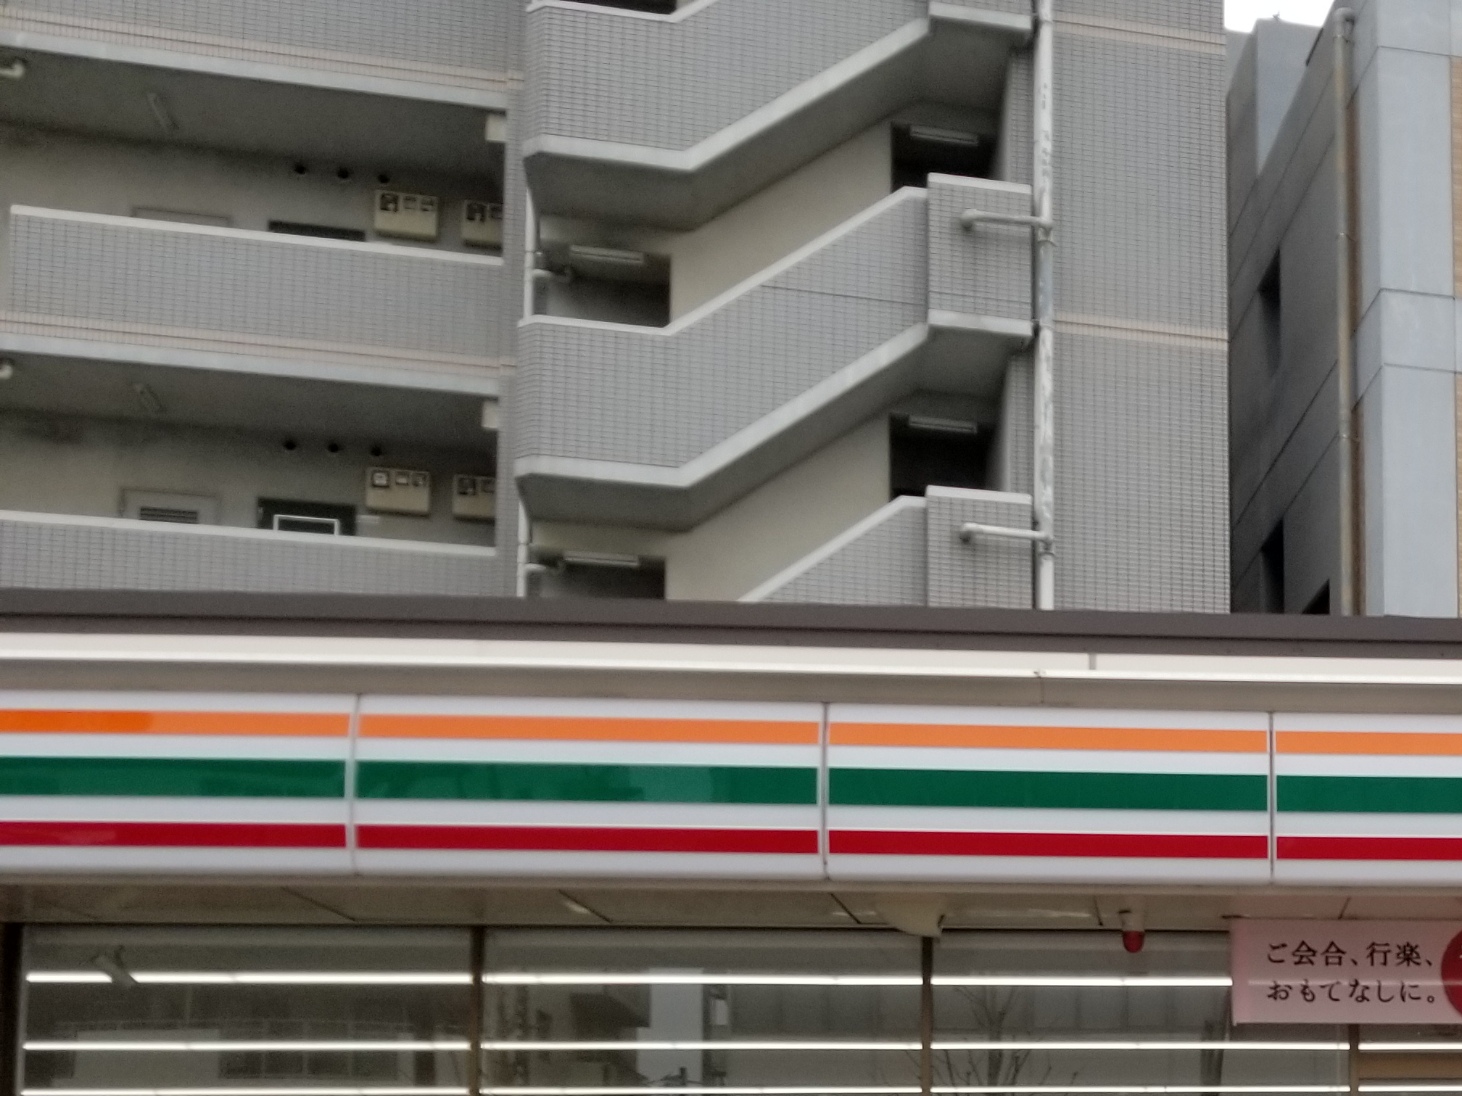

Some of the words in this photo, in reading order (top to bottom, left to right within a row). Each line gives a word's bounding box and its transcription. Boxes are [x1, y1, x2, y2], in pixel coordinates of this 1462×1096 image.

[1266, 941, 1436, 968] ご会合、行楽、
[1268, 979, 1437, 1004] おもてなしに。
